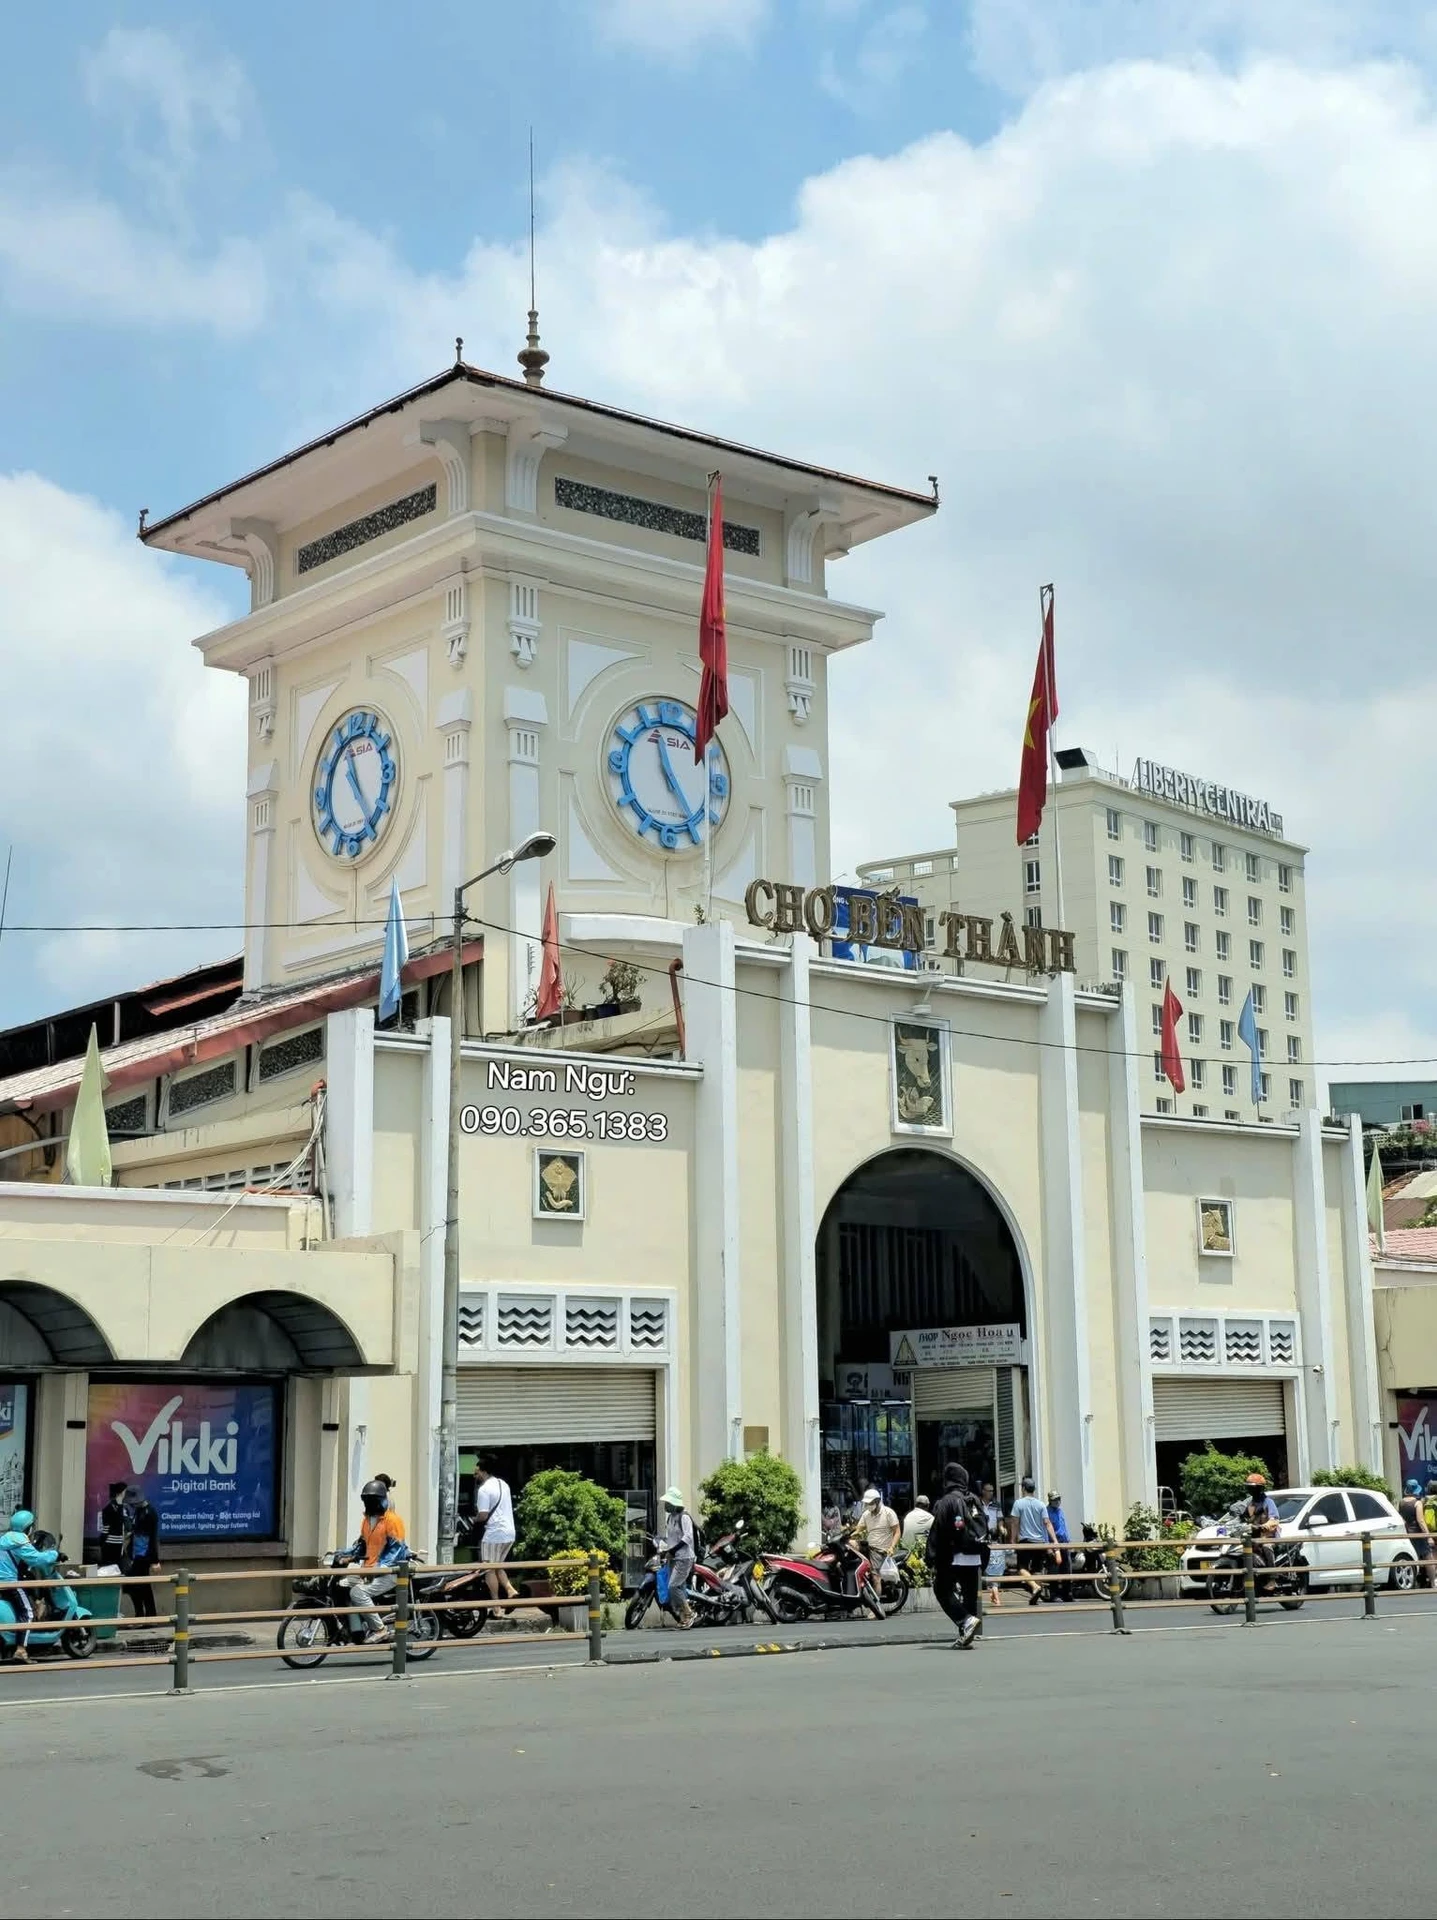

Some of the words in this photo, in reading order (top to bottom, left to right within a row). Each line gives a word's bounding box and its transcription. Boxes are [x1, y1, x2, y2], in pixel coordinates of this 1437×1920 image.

[1138, 757, 1203, 807] LIBERTY
[1205, 782, 1276, 831] CENTRAL
[849, 886, 926, 951] BẾN
[938, 910, 1077, 975] THÀNH
[111, 1395, 239, 1475] Vikki
[172, 1480, 207, 1493] Digital
[210, 1480, 236, 1490] Bank
